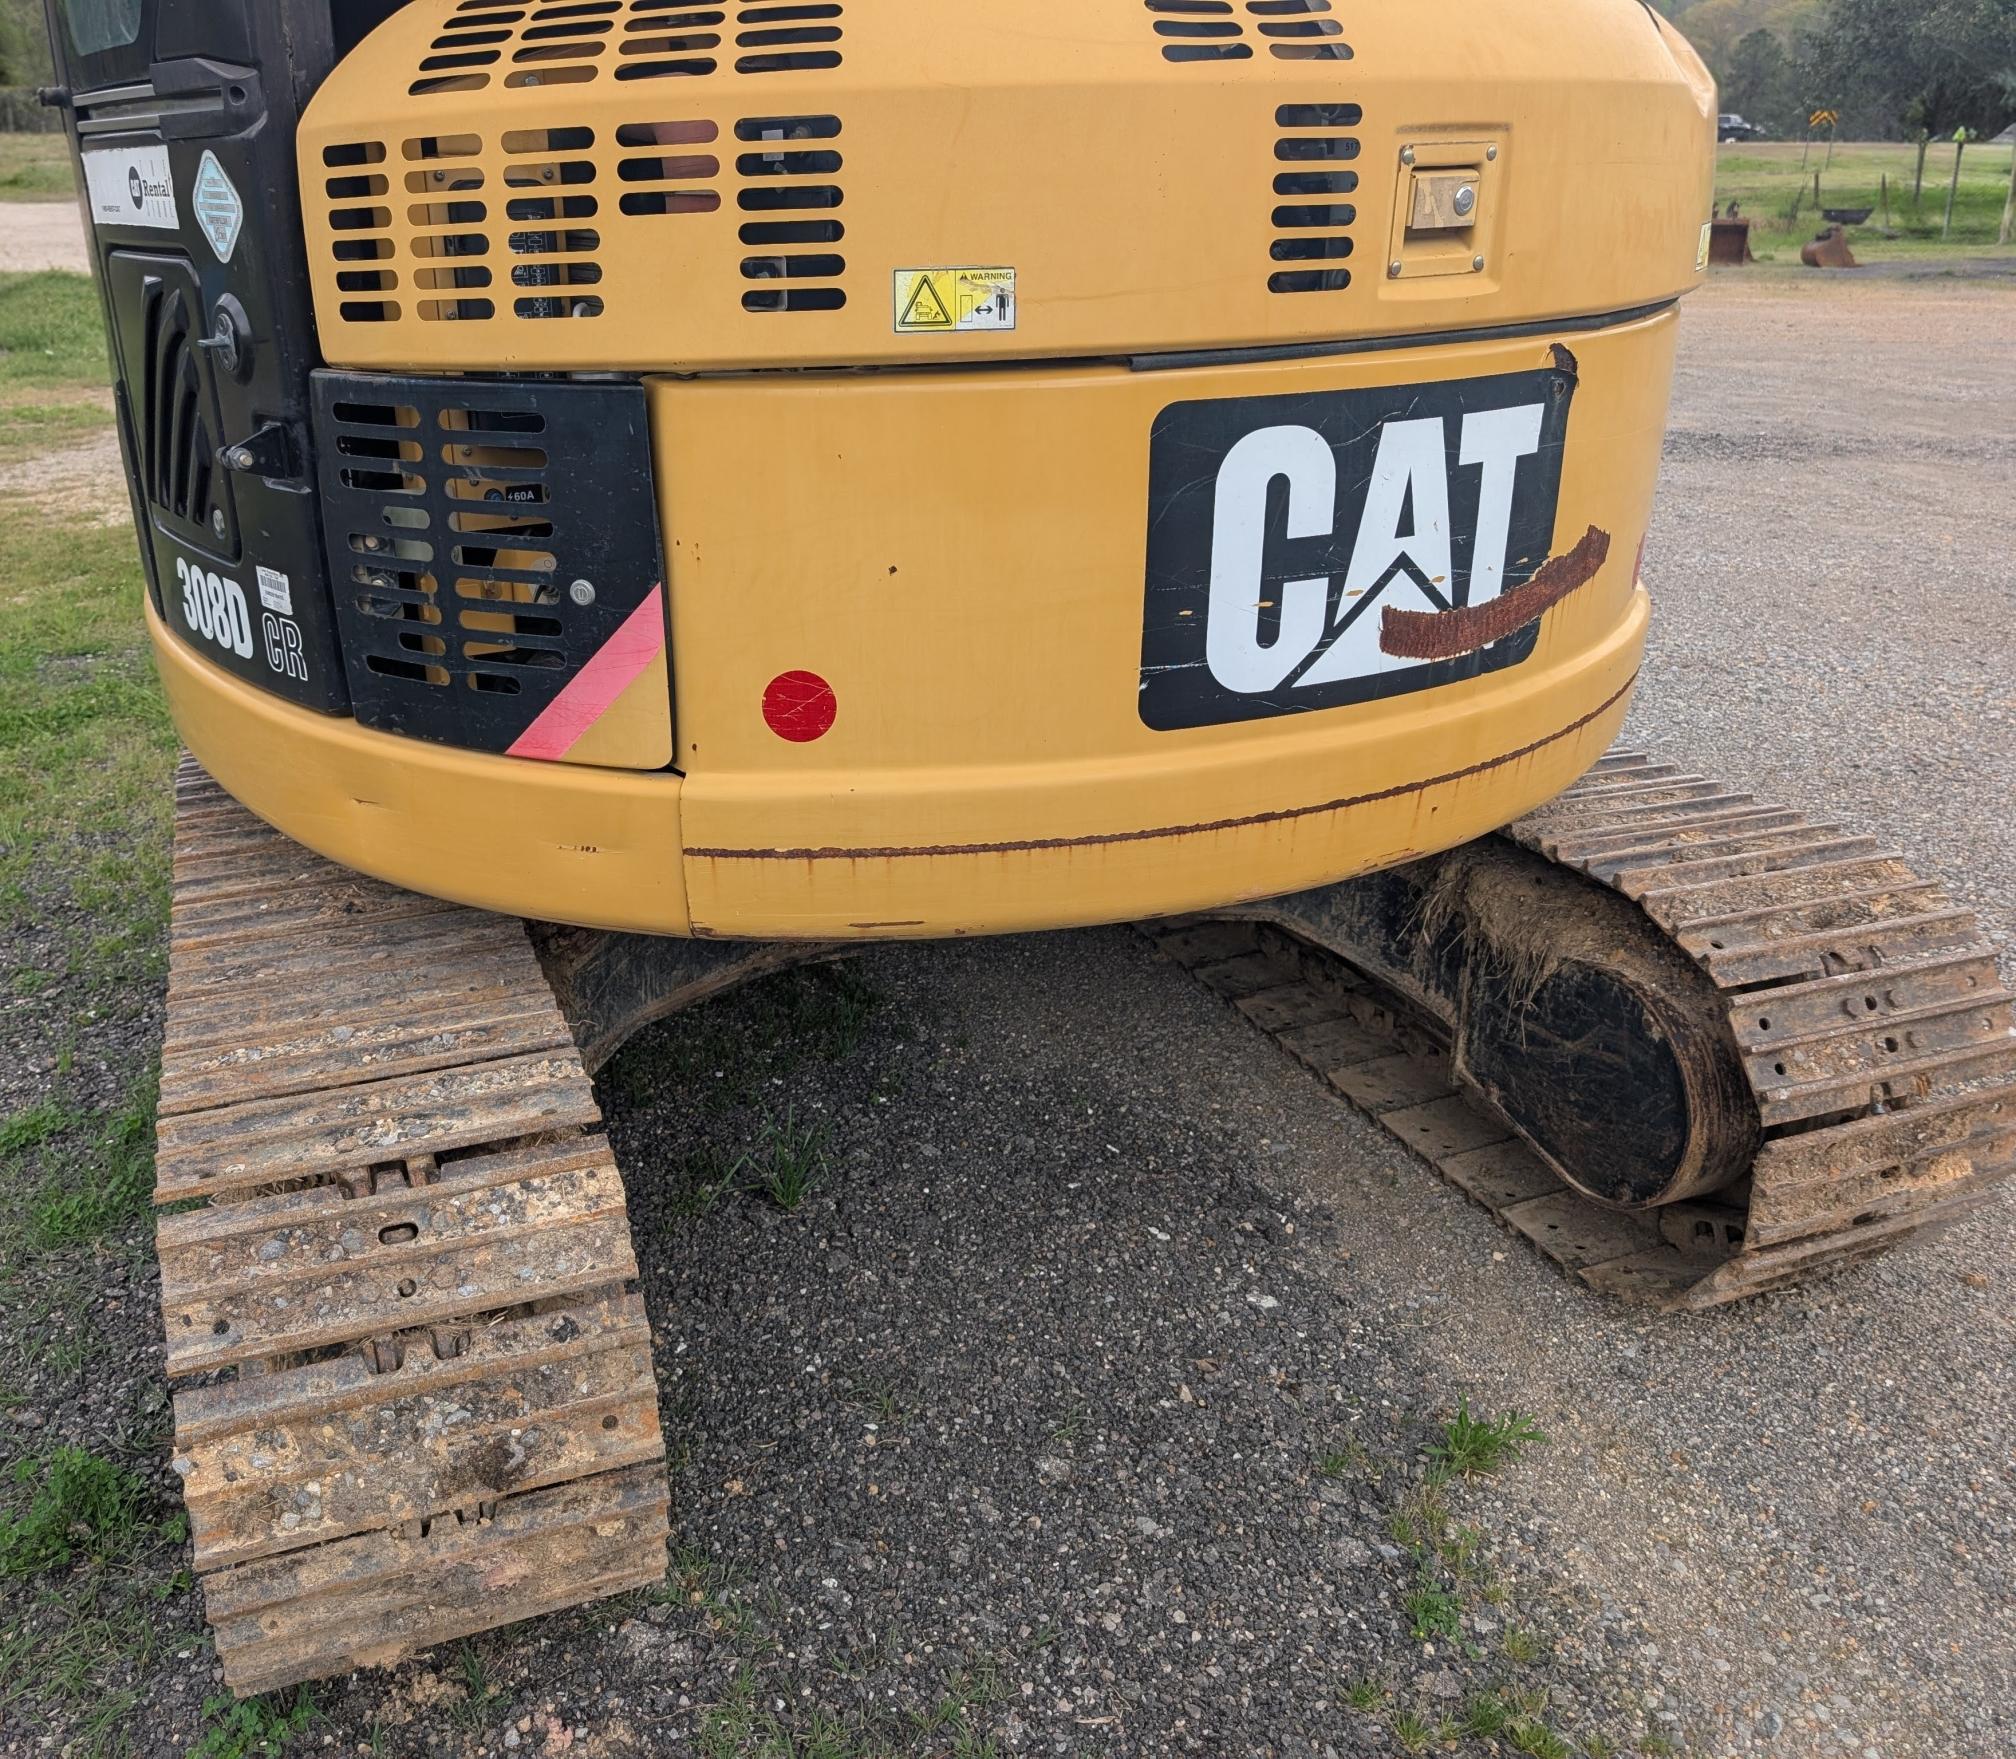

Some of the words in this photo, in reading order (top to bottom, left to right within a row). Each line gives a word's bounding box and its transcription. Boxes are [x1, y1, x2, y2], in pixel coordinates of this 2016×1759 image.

[142, 179, 170, 197] Rental
[970, 272, 1011, 280] WARNING
[514, 490, 535, 501] 60A
[1206, 402, 1545, 694] CAT
[176, 557, 253, 659] 308D
[262, 613, 308, 681] CR
